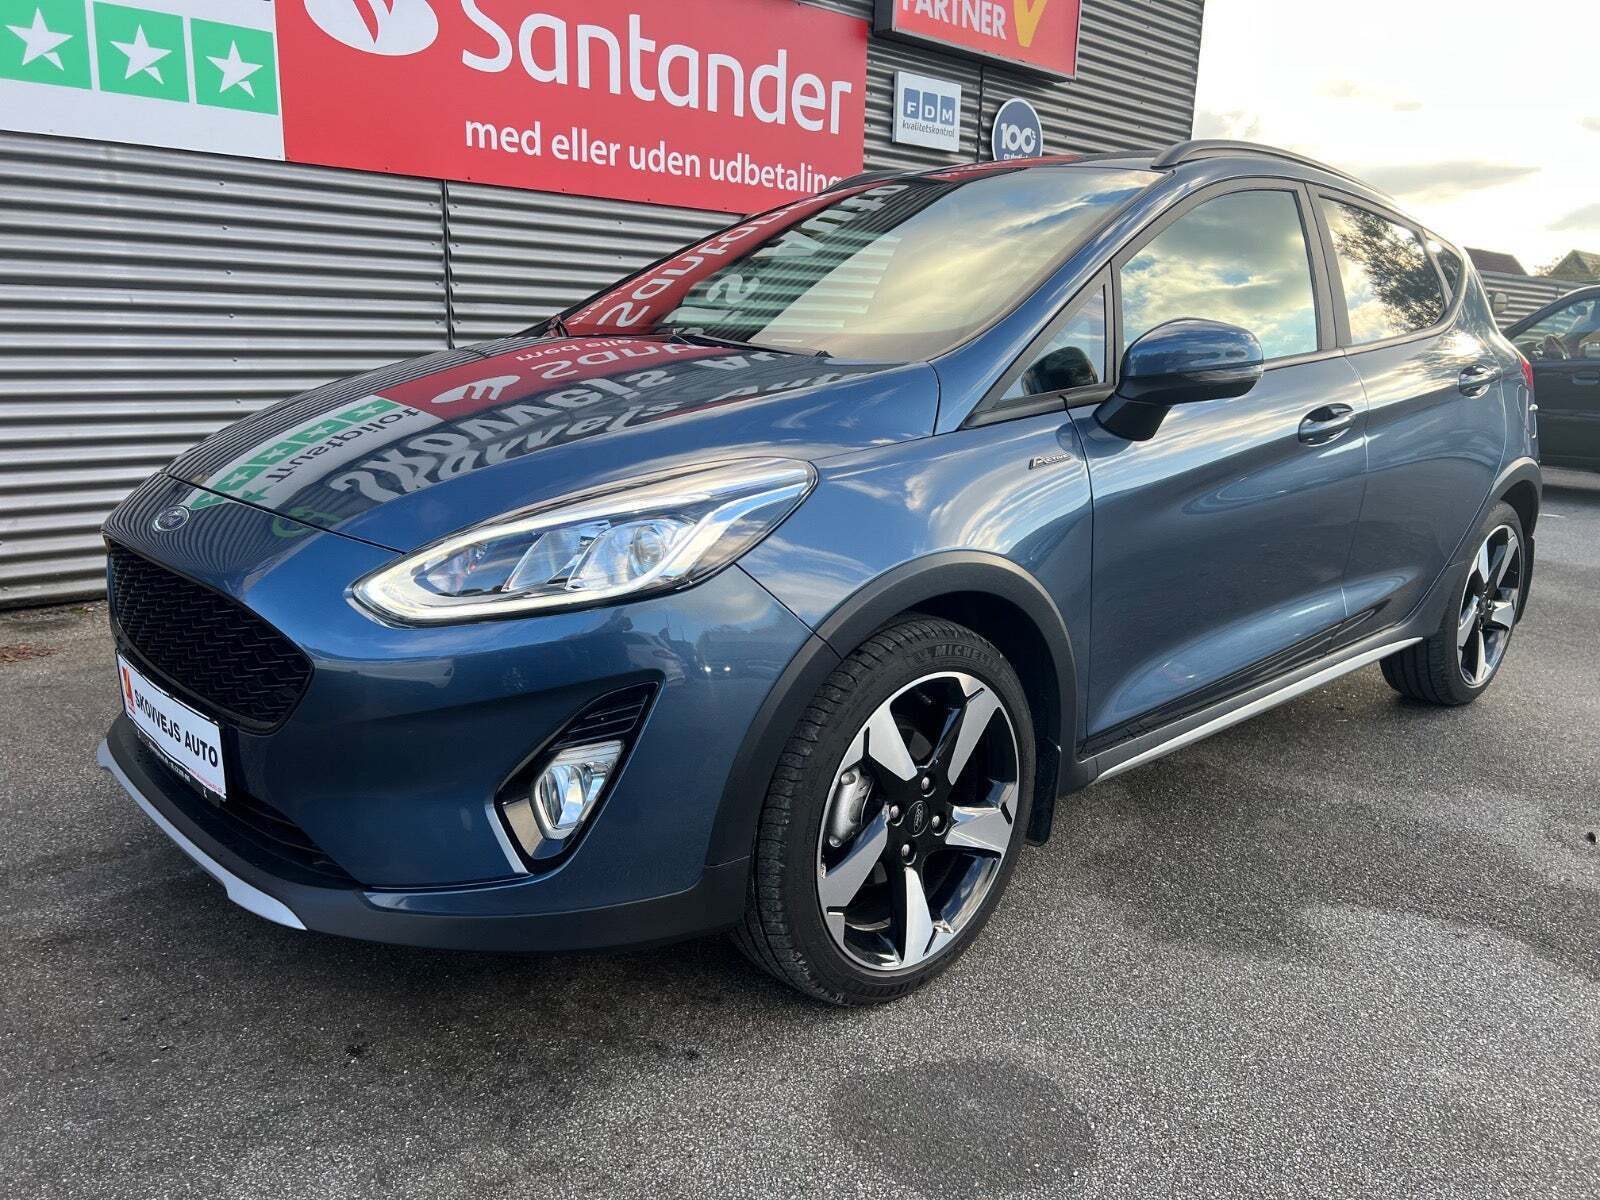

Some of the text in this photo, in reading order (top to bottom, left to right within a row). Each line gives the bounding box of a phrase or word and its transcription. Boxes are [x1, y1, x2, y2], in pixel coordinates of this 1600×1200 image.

[461, 0, 852, 135] Santander
[902, 119, 955, 138] kvalitetskontrol
[906, 102, 953, 122] FDM
[465, 119, 542, 157] med
[551, 126, 621, 167] eller
[629, 140, 701, 178] uden
[184, 731, 219, 768] AUTO
